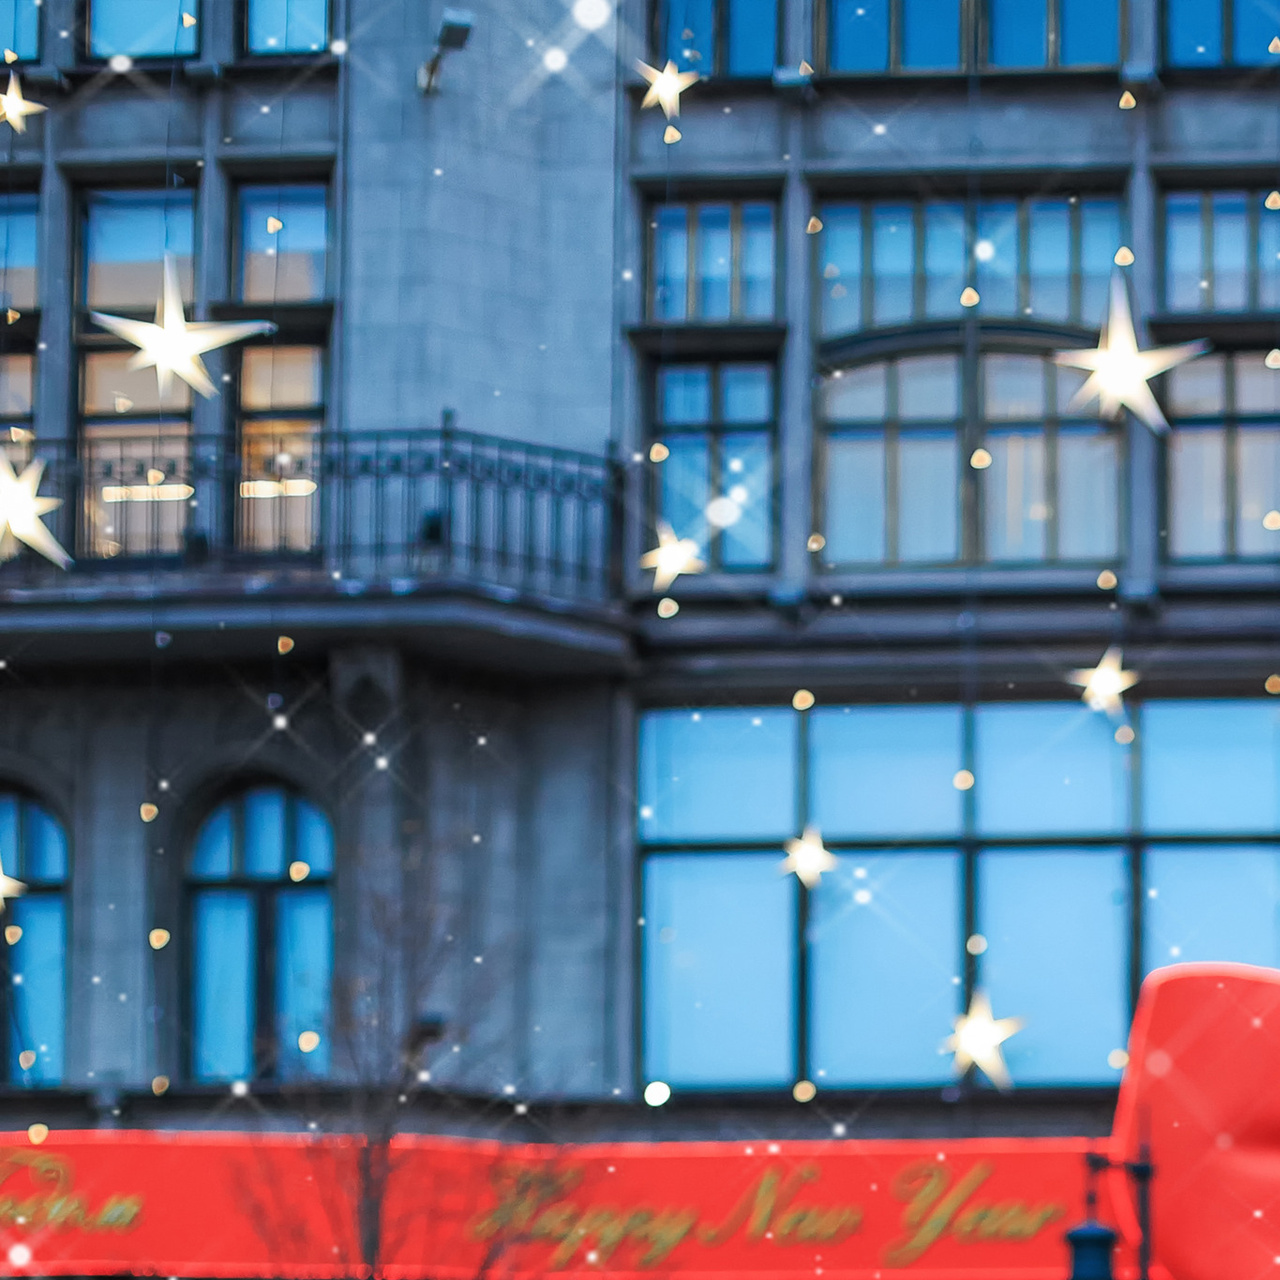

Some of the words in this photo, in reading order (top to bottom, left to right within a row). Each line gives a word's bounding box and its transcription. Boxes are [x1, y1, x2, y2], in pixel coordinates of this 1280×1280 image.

[465, 1160, 698, 1268] Happy
[700, 1164, 862, 1246] New
[882, 1160, 1068, 1268] Year
